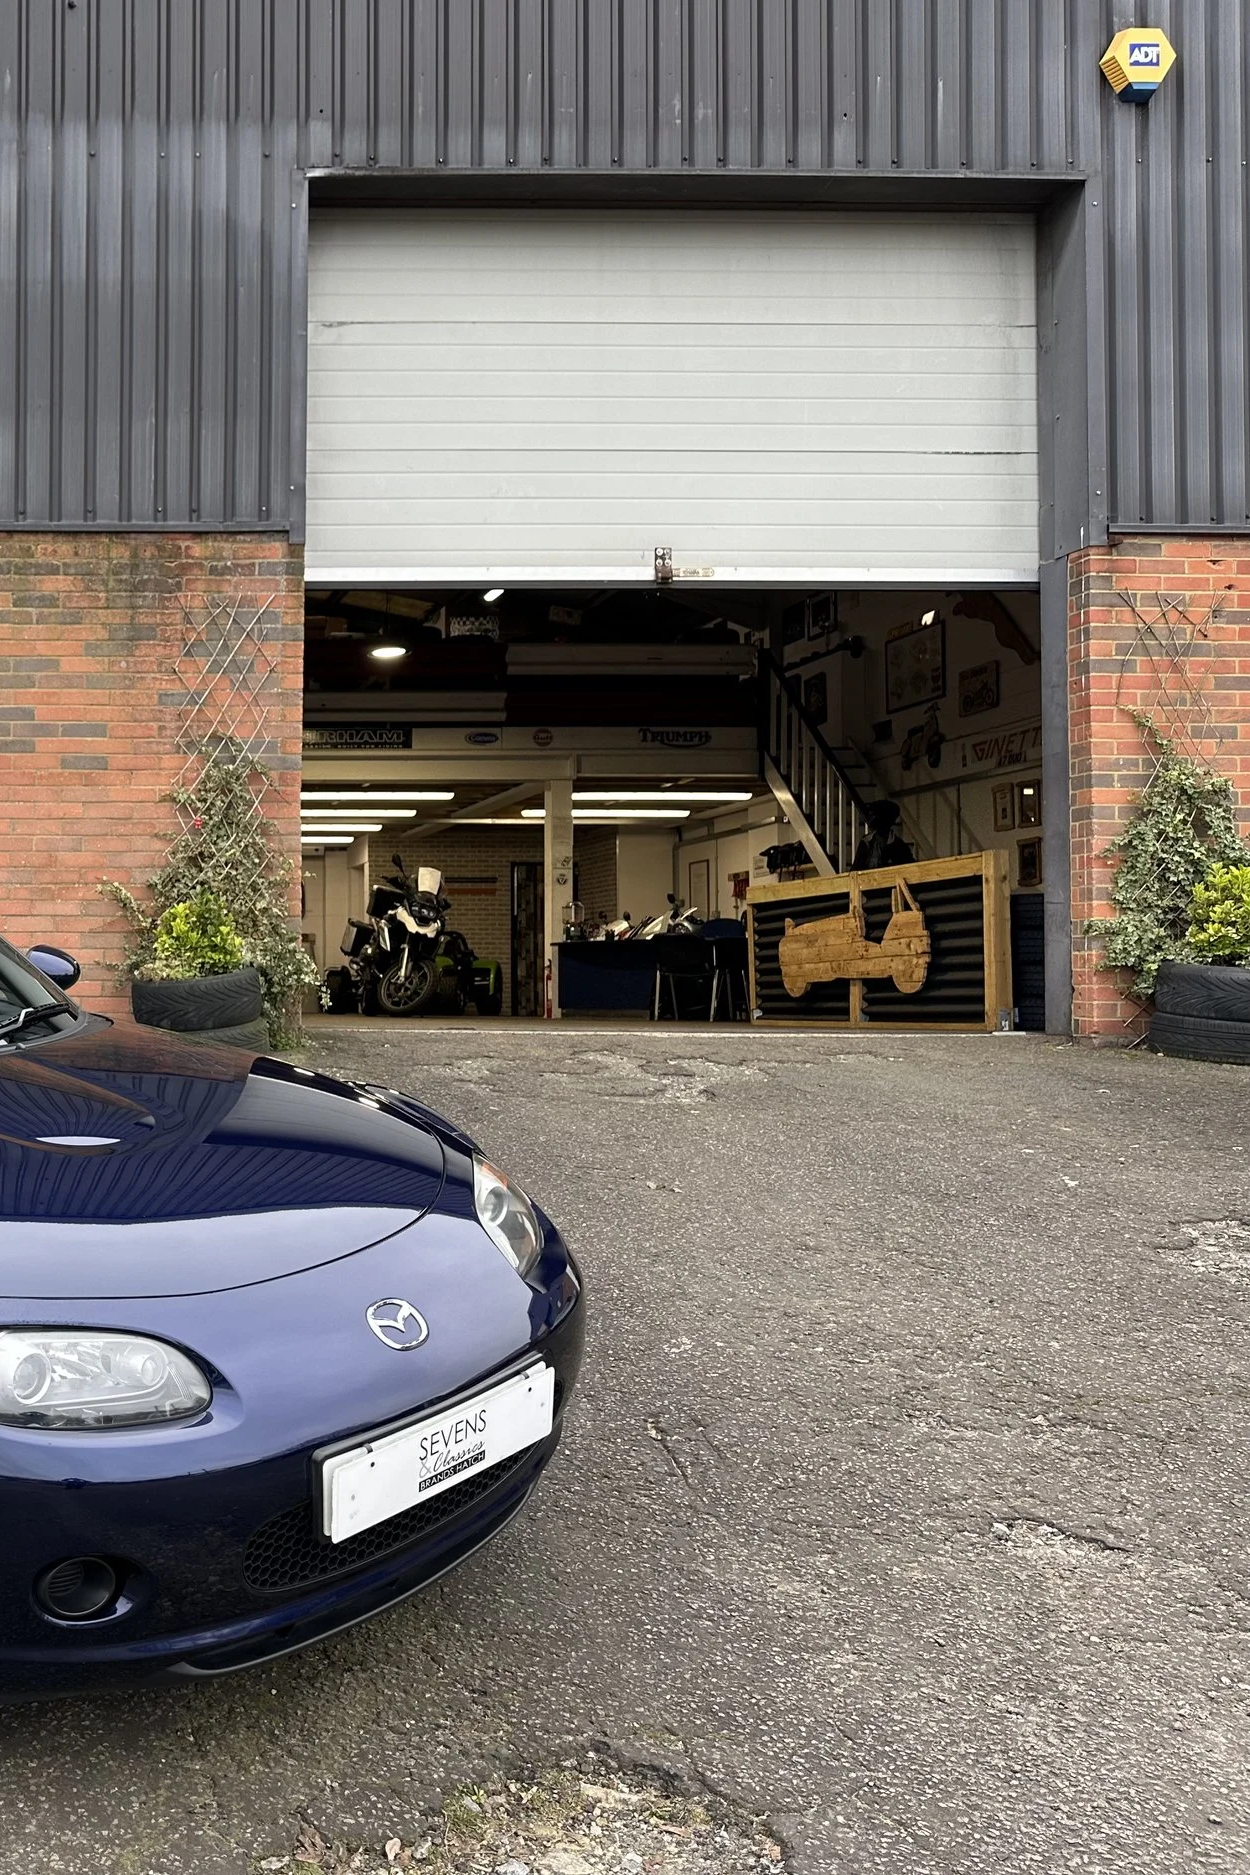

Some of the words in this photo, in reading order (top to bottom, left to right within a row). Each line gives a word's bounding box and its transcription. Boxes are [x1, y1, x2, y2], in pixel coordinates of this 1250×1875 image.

[1130, 46, 1160, 63] ADT
[638, 727, 712, 746] TRIUMPH
[419, 1409, 487, 1460] SEVENS
[433, 1440, 486, 1471] Classics
[420, 1468, 454, 1490] BRANDS
[457, 1453, 485, 1471] HATCH
